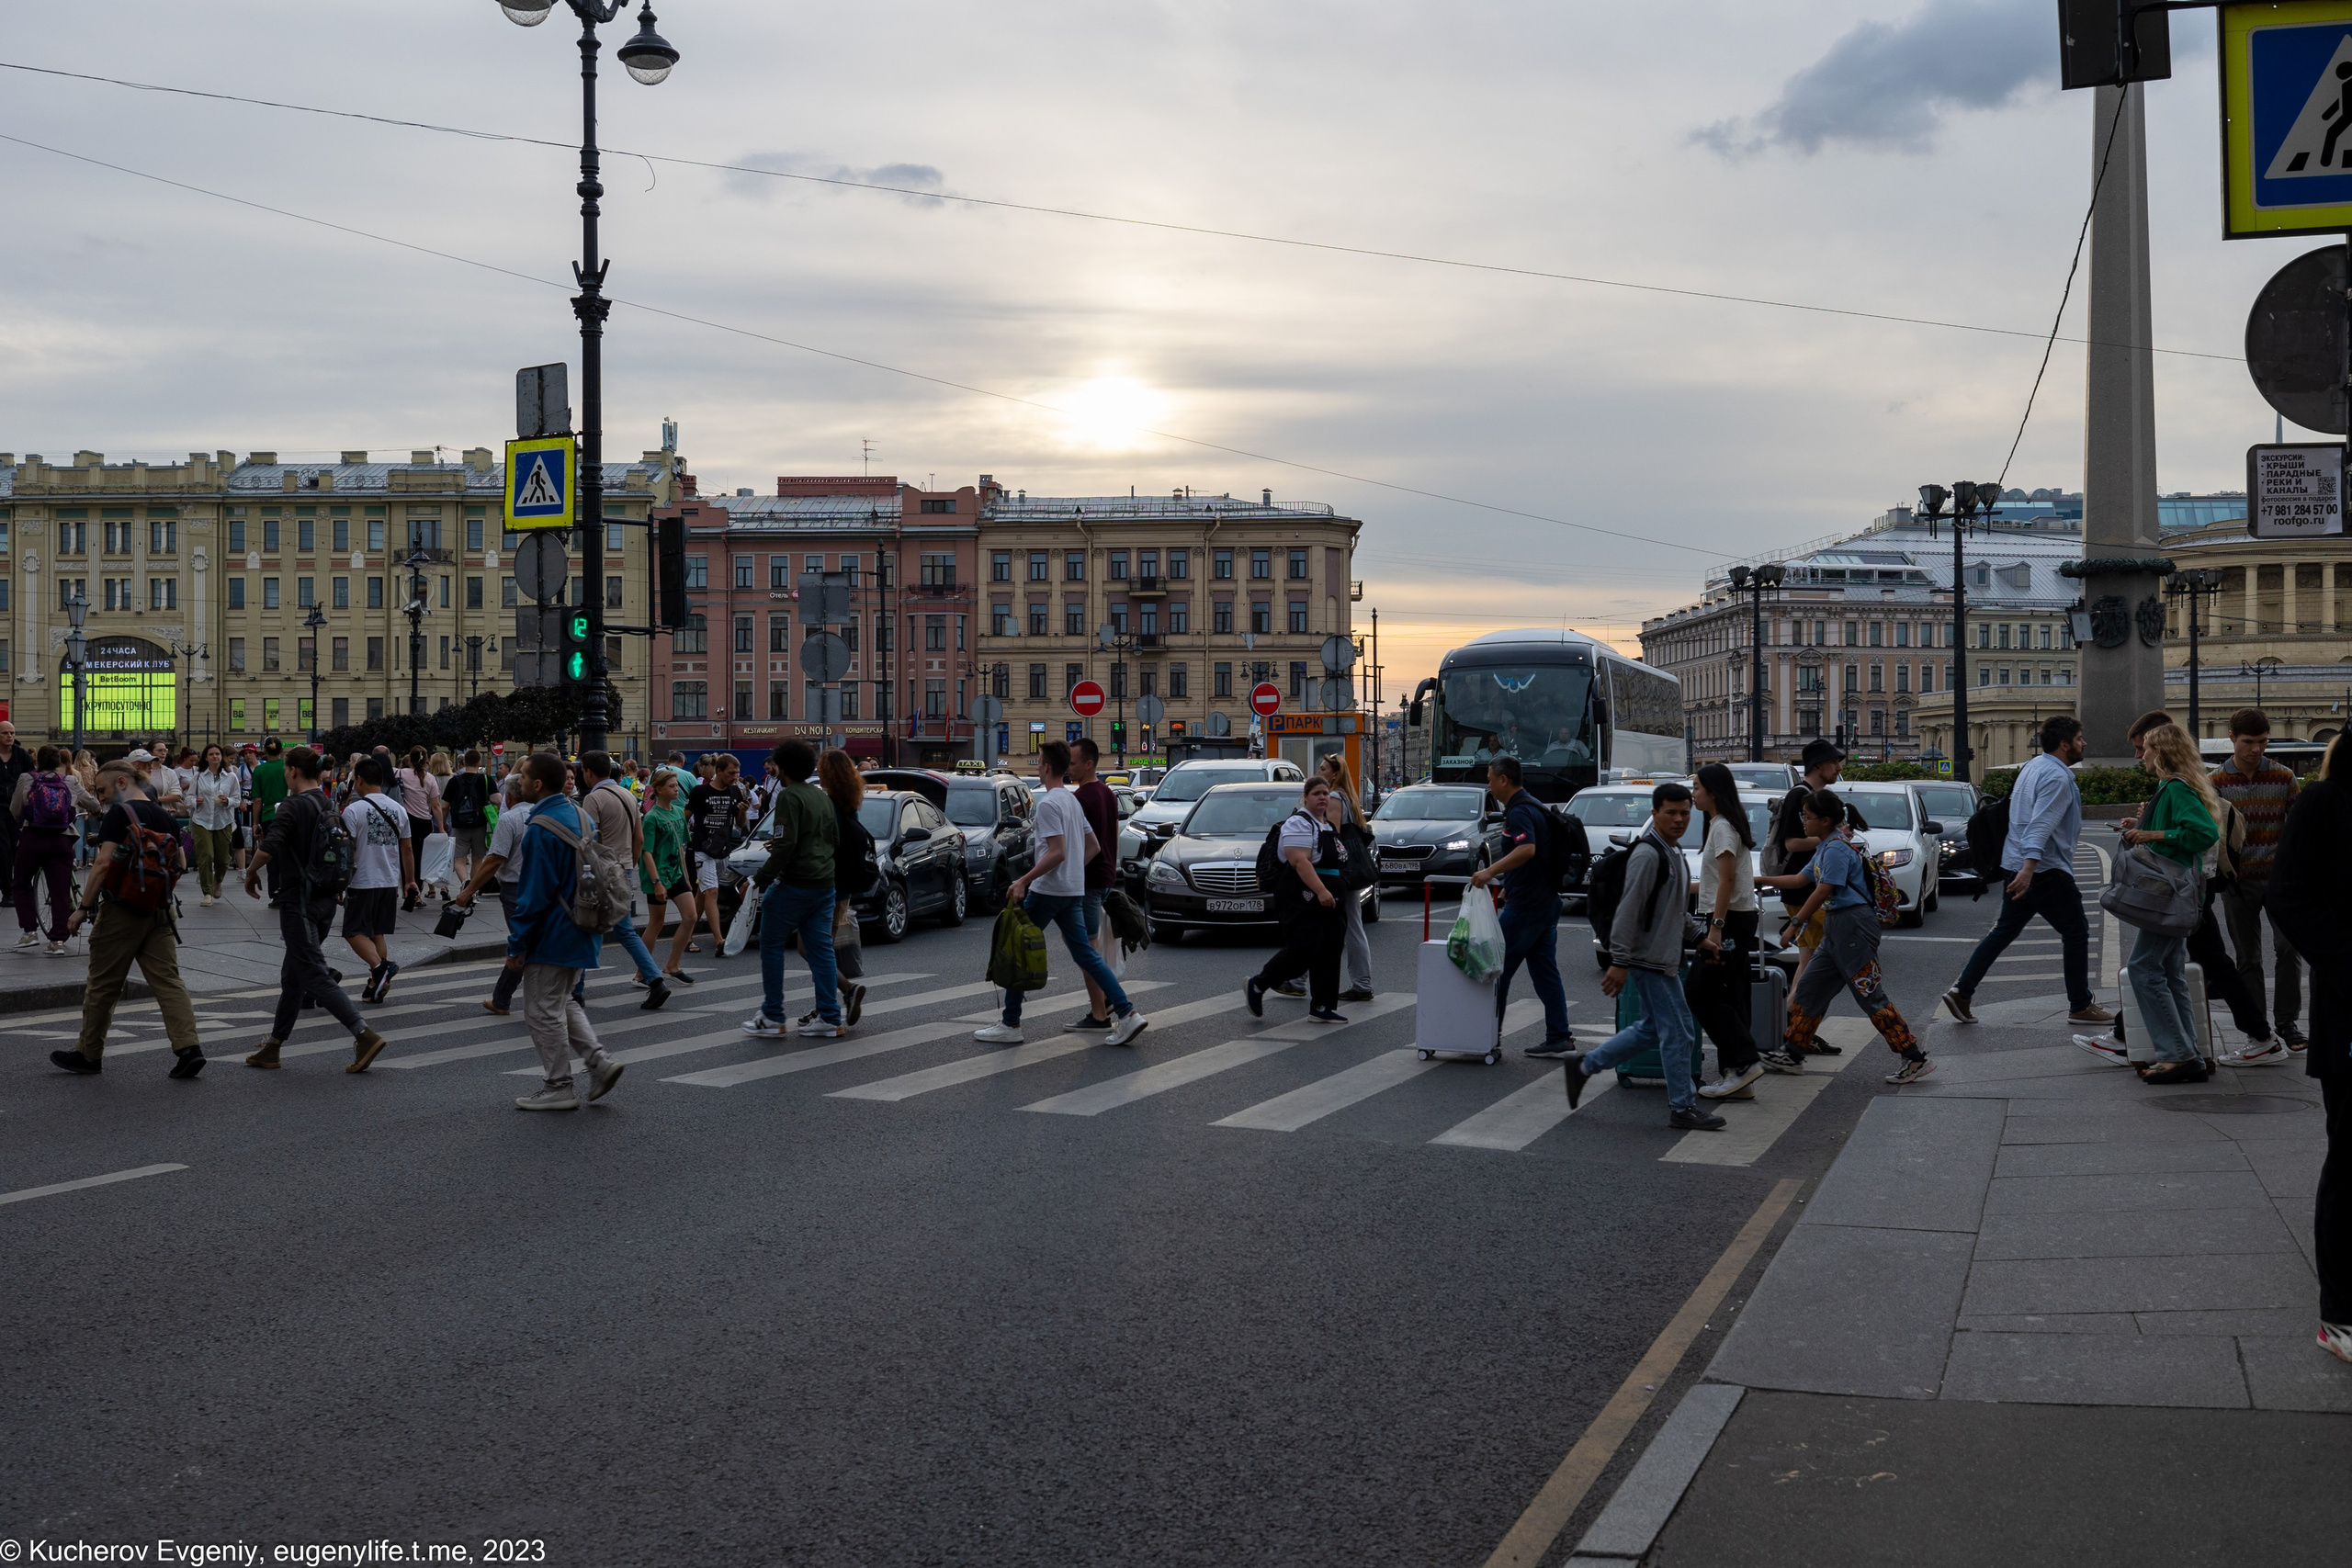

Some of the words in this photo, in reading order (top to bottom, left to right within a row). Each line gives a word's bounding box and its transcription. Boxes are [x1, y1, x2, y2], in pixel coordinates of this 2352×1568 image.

[2261, 454, 2305, 462] ЭКСКУРСИИ:
[2267, 469, 2322, 478] ПАРАДНЫЕ
[2295, 478, 2302, 486] И
[2261, 496, 2301, 504] фотосессия
[2261, 505, 2273, 516] +7
[2275, 505, 2291, 516] 981
[2294, 504, 2312, 515] 284
[2312, 504, 2324, 515] 57
[2326, 503, 2338, 514] 00
[2274, 516, 2324, 527] roofgo.ru
[66, 659, 142, 669] БМЕКЕРСКИЙ
[1286, 716, 1323, 728] ПАРК
